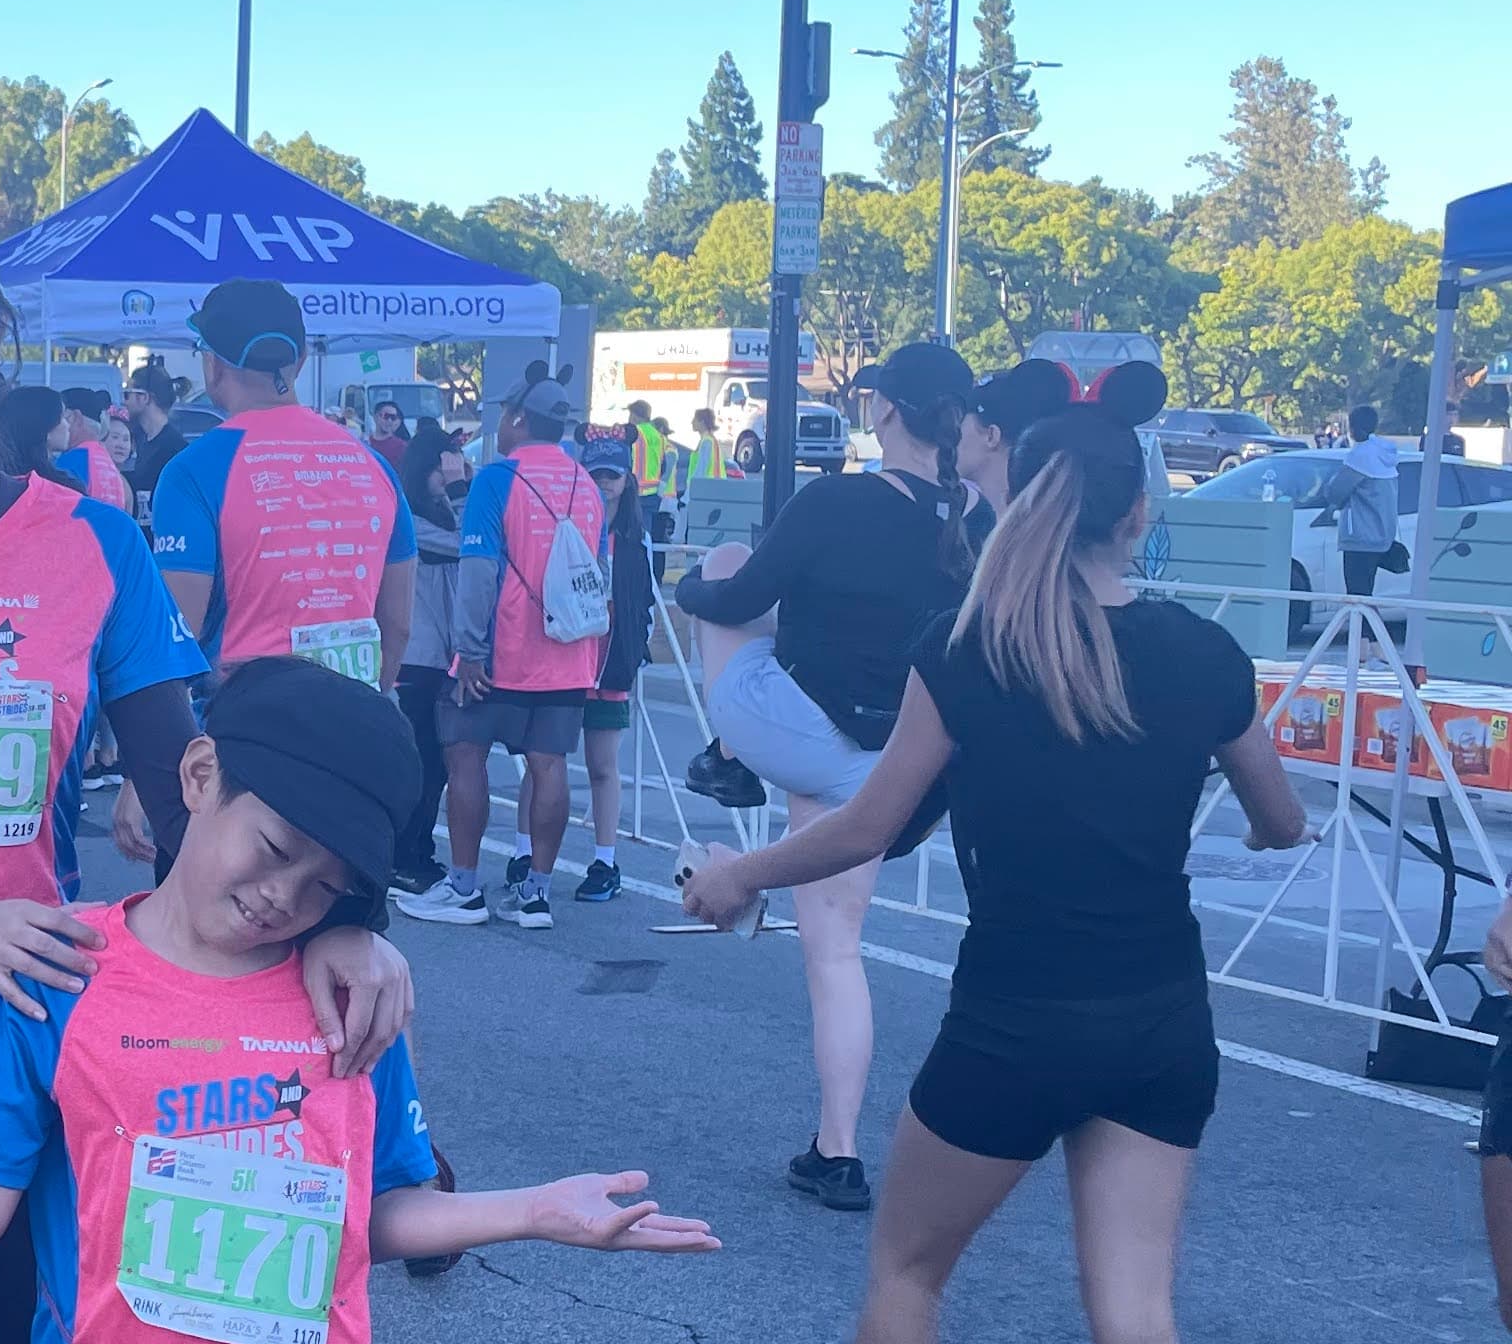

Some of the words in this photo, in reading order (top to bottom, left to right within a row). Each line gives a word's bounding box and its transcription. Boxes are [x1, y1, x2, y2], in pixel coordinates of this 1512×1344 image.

[781, 126, 799, 143] NO
[781, 148, 819, 163] PARKING
[780, 207, 817, 220] METERED
[150, 210, 354, 264] VHP
[780, 224, 817, 240] PARKING
[189, 290, 505, 324] ealthplan.org
[1493, 719, 1507, 731] 45
[3, 822, 35, 838] 1219
[239, 1036, 311, 1054] TARANA
[155, 1072, 278, 1137] STARS
[280, 1085, 304, 1104] AND
[231, 1167, 258, 1193] 5K
[138, 1199, 329, 1310] 1170
